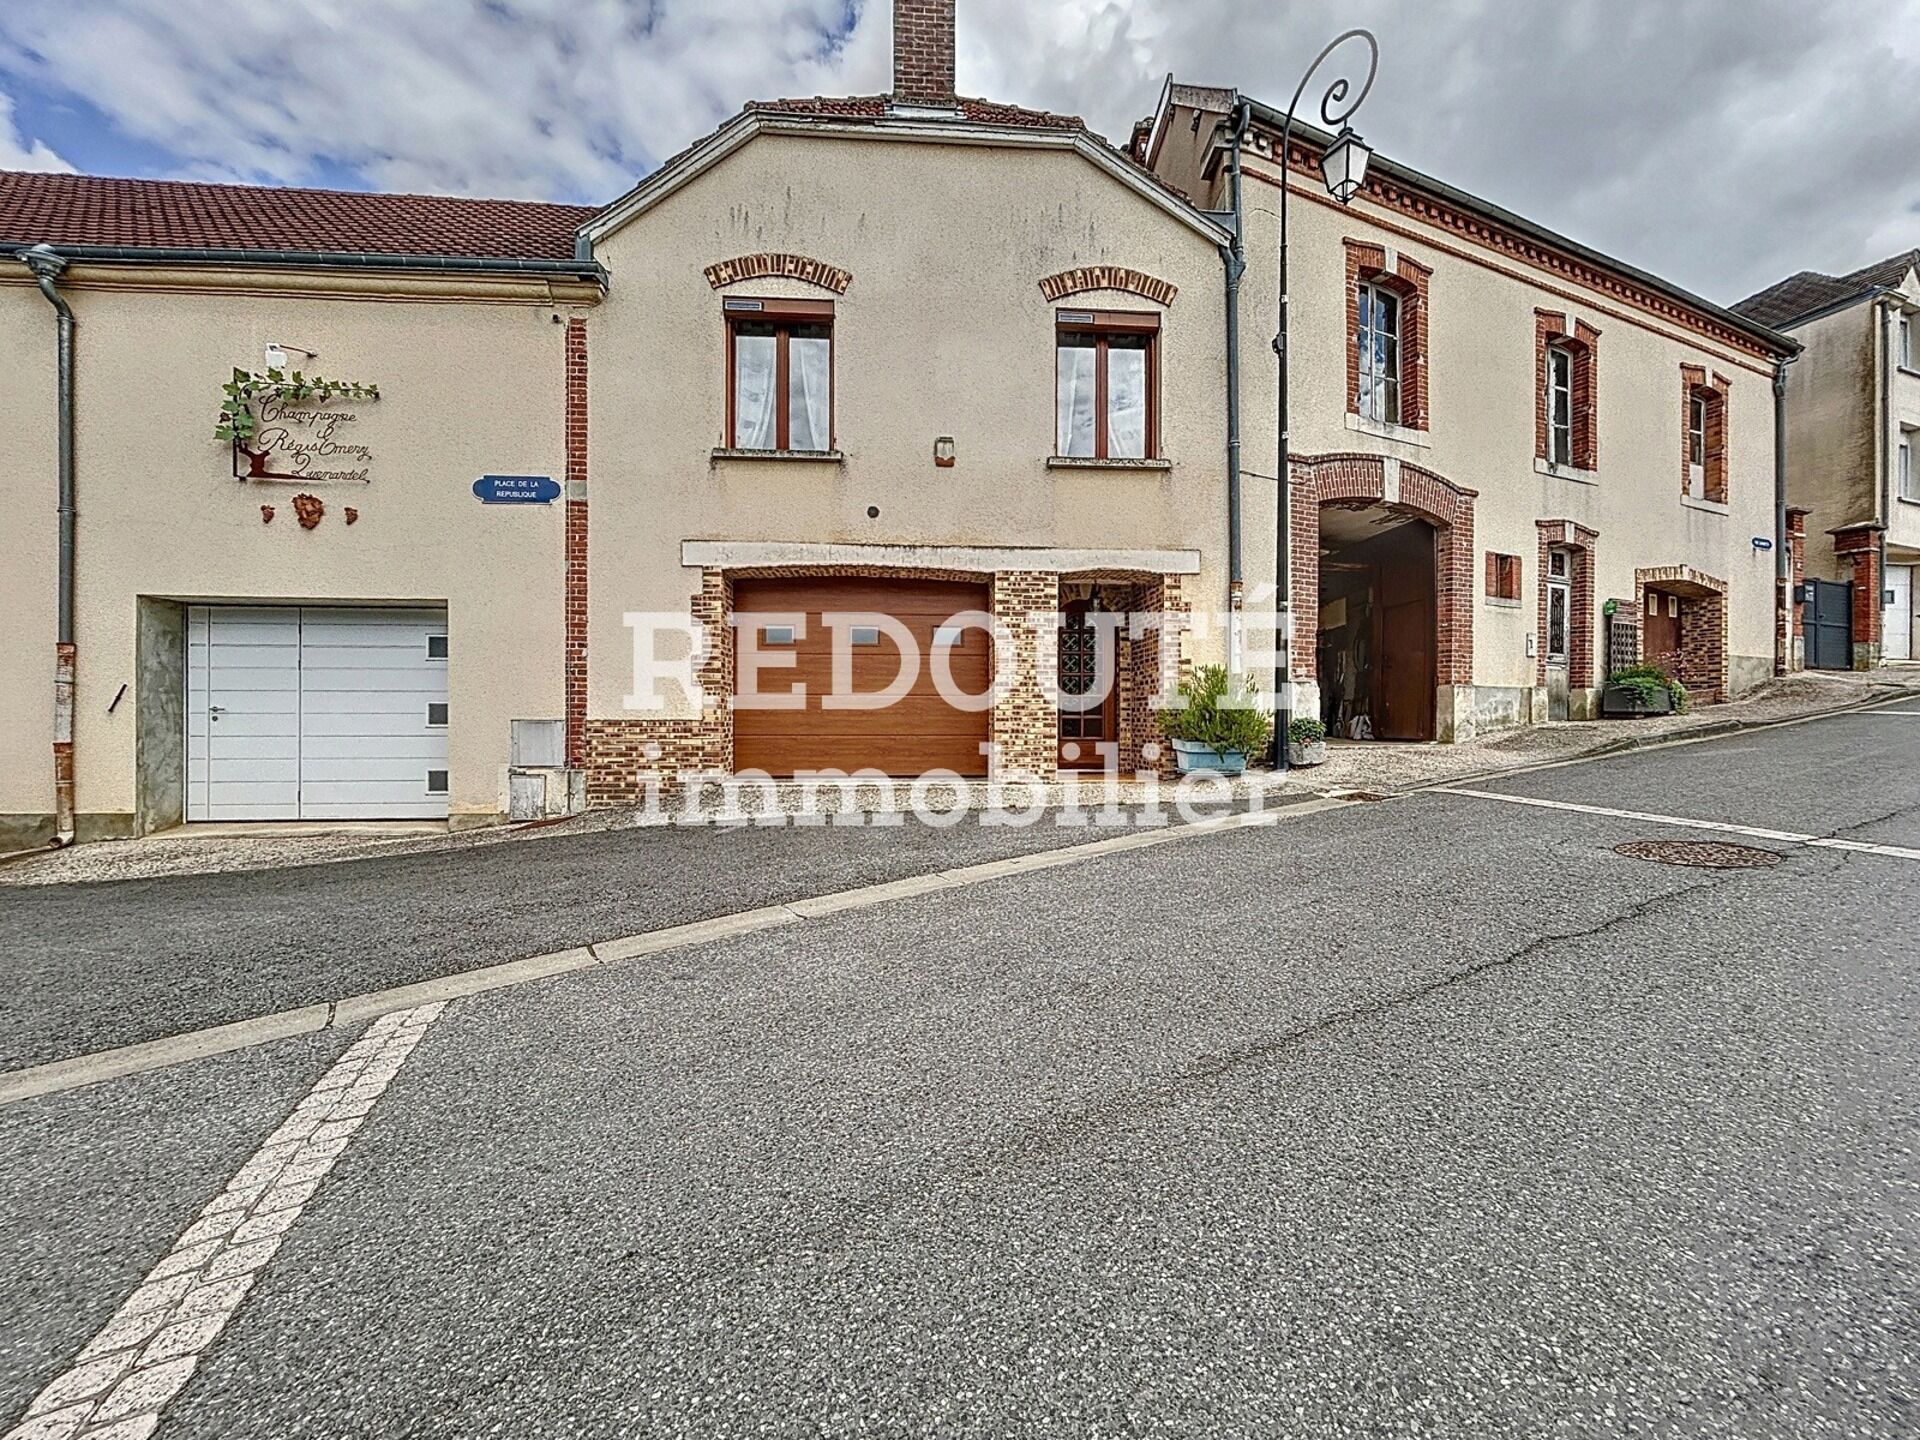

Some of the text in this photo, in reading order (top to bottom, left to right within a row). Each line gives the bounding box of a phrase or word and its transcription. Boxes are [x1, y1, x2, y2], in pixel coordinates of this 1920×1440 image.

[258, 394, 357, 428] Champagne
[257, 427, 372, 461] Régis Emery
[494, 480, 516, 488] PLACE
